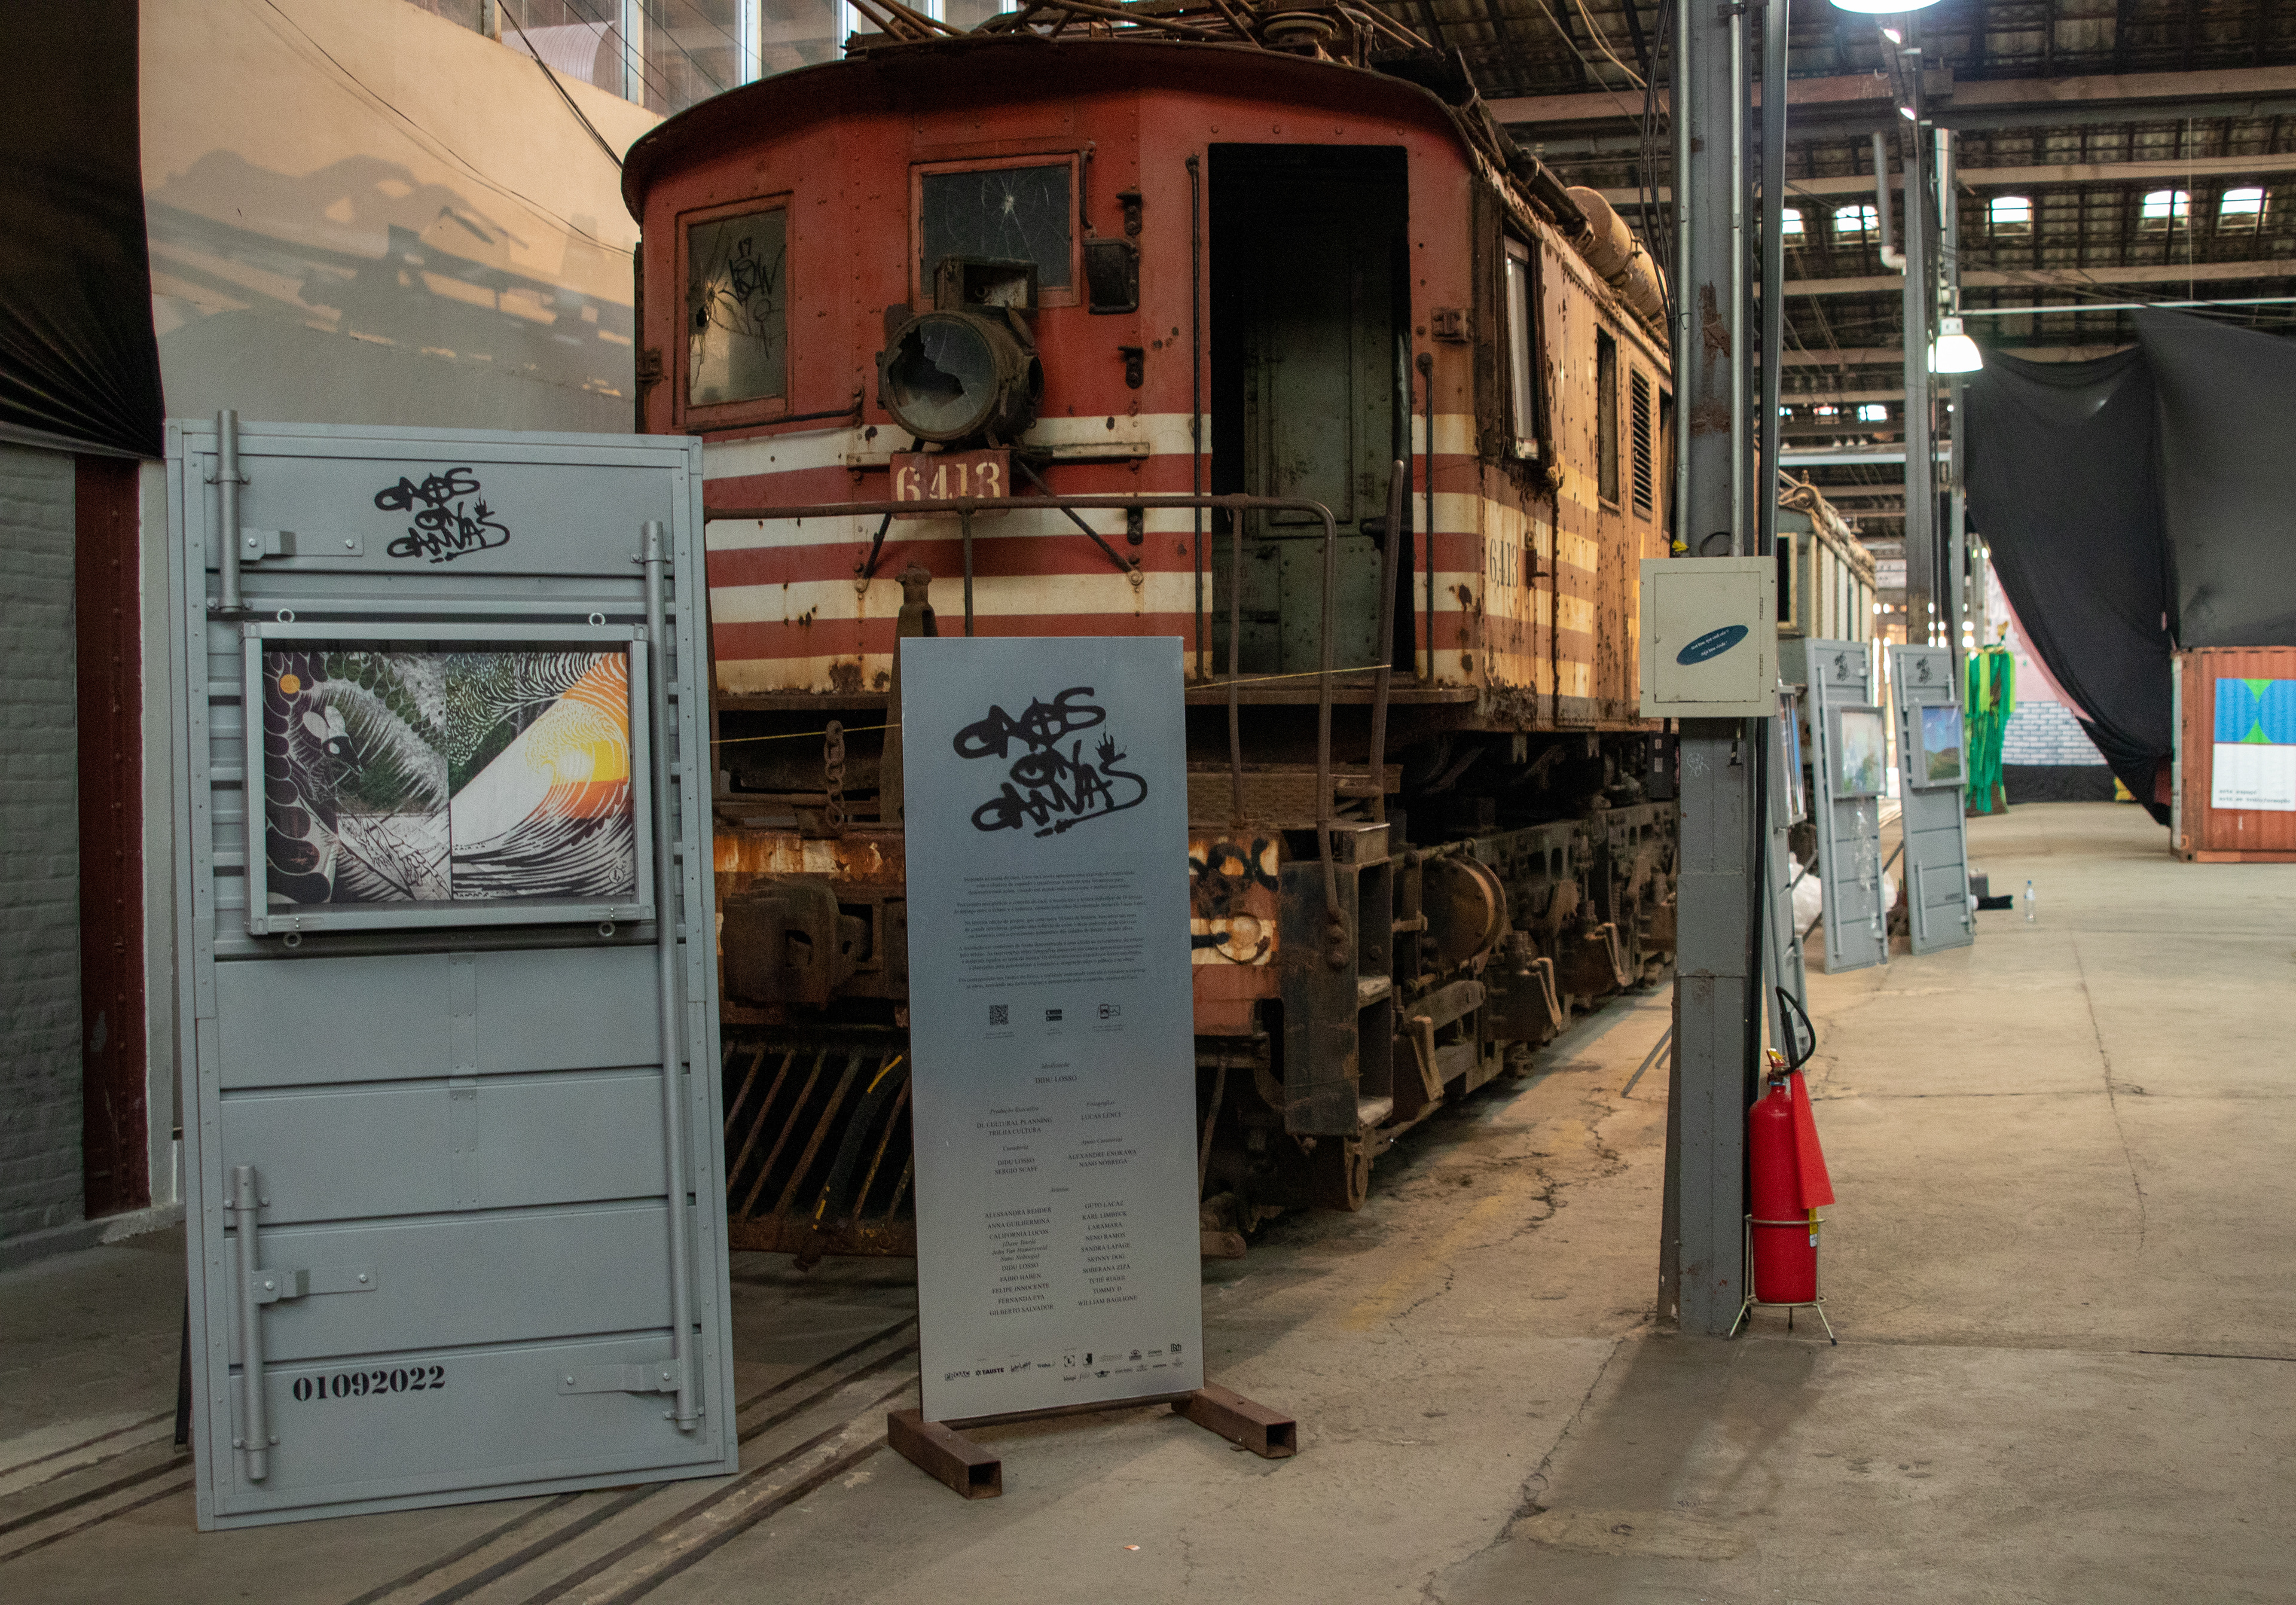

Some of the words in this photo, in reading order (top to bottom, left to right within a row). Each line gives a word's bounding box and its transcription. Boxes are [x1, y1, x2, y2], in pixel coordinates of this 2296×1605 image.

[897, 462, 1002, 501] 6413
[985, 1209, 1025, 1218] ALESSANDRA
[989, 1231, 1027, 1240] CALIFORNIA
[998, 1296, 1032, 1304] FERNANDA
[1077, 1298, 1105, 1307] WILLIAM
[1021, 1304, 1054, 1313] SALVADOR
[292, 1365, 445, 1402] 01092022
